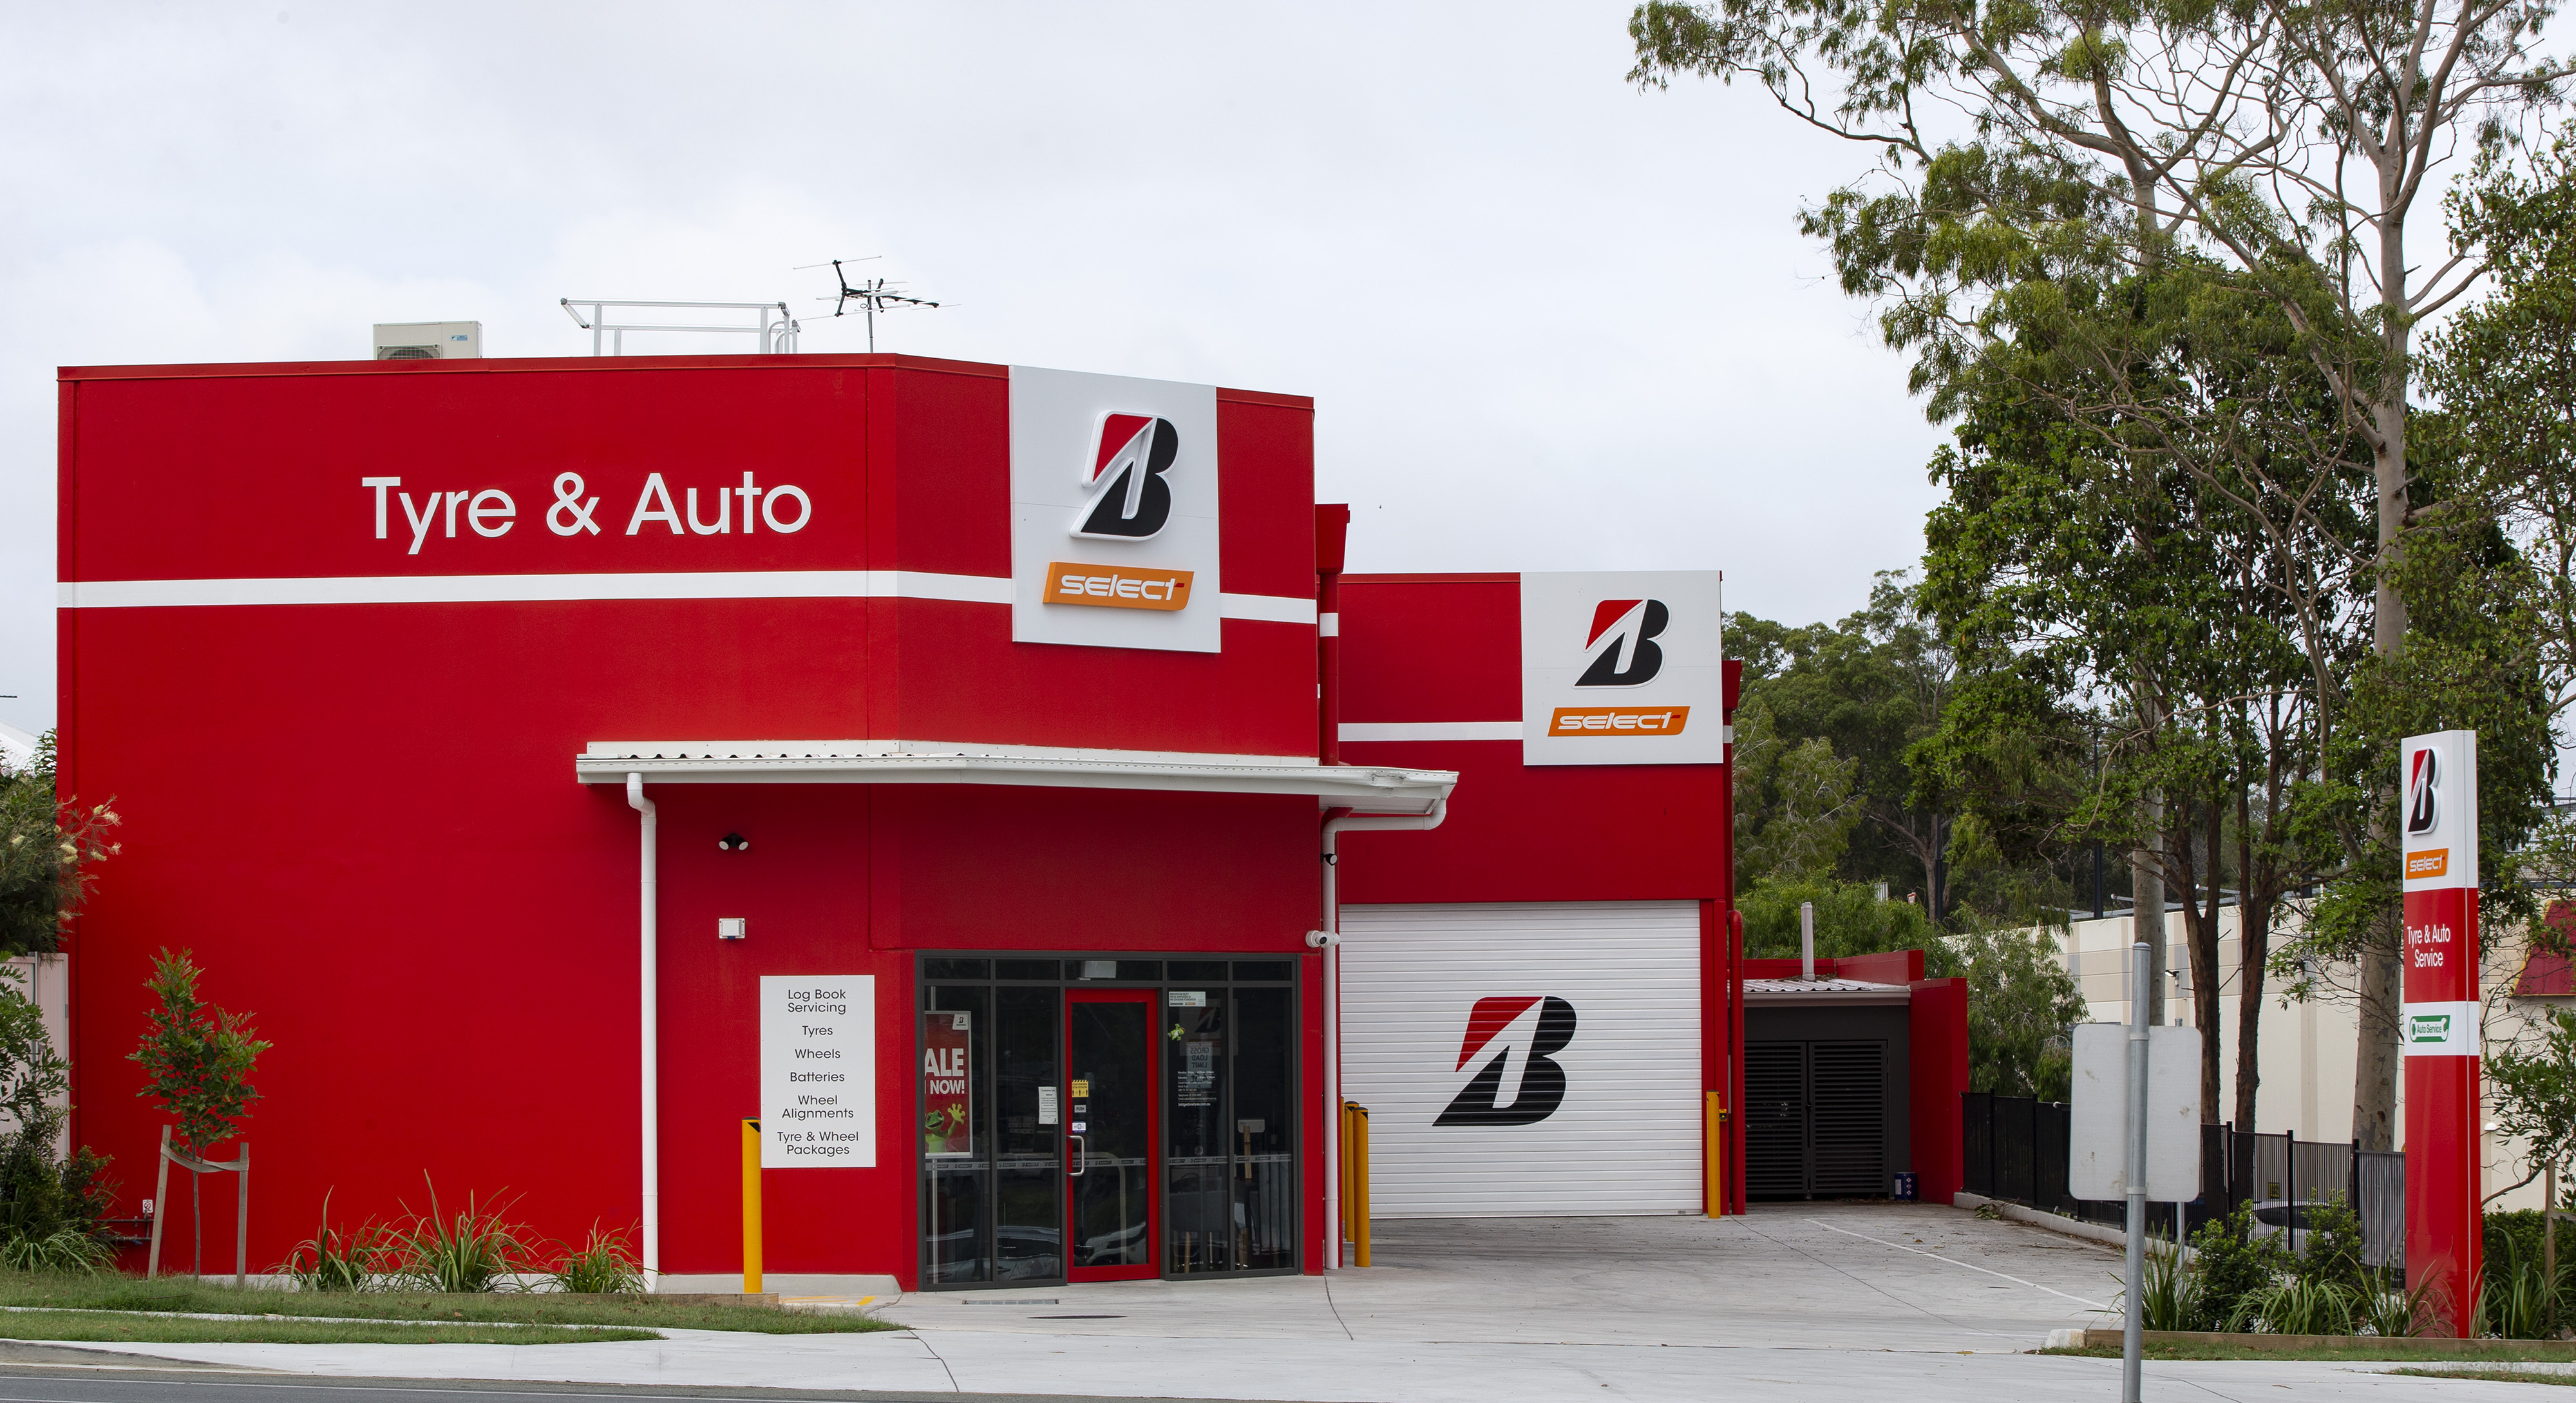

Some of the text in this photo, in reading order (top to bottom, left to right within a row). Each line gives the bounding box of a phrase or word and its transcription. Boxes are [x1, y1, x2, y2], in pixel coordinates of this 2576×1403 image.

[362, 471, 811, 555] Tyre & Auto
[1059, 574, 1176, 600] select
[1558, 712, 1672, 730] select
[2409, 854, 2443, 872] select
[2407, 924, 2451, 949] Tyre & Auto
[2414, 948, 2443, 968] Service
[788, 989, 846, 1002] Log Book
[788, 1002, 846, 1015] Servicing
[802, 1026, 833, 1037] Tyres
[2416, 1024, 2441, 1033] Auto Service
[795, 1049, 840, 1059] Wheels
[790, 1071, 845, 1082] Batteries
[930, 1080, 965, 1094] NOW!
[797, 1094, 837, 1105] Wheel
[782, 1108, 854, 1121] Alignments
[777, 1131, 858, 1143] Tyre & Wheel
[786, 1145, 849, 1158] Packages
